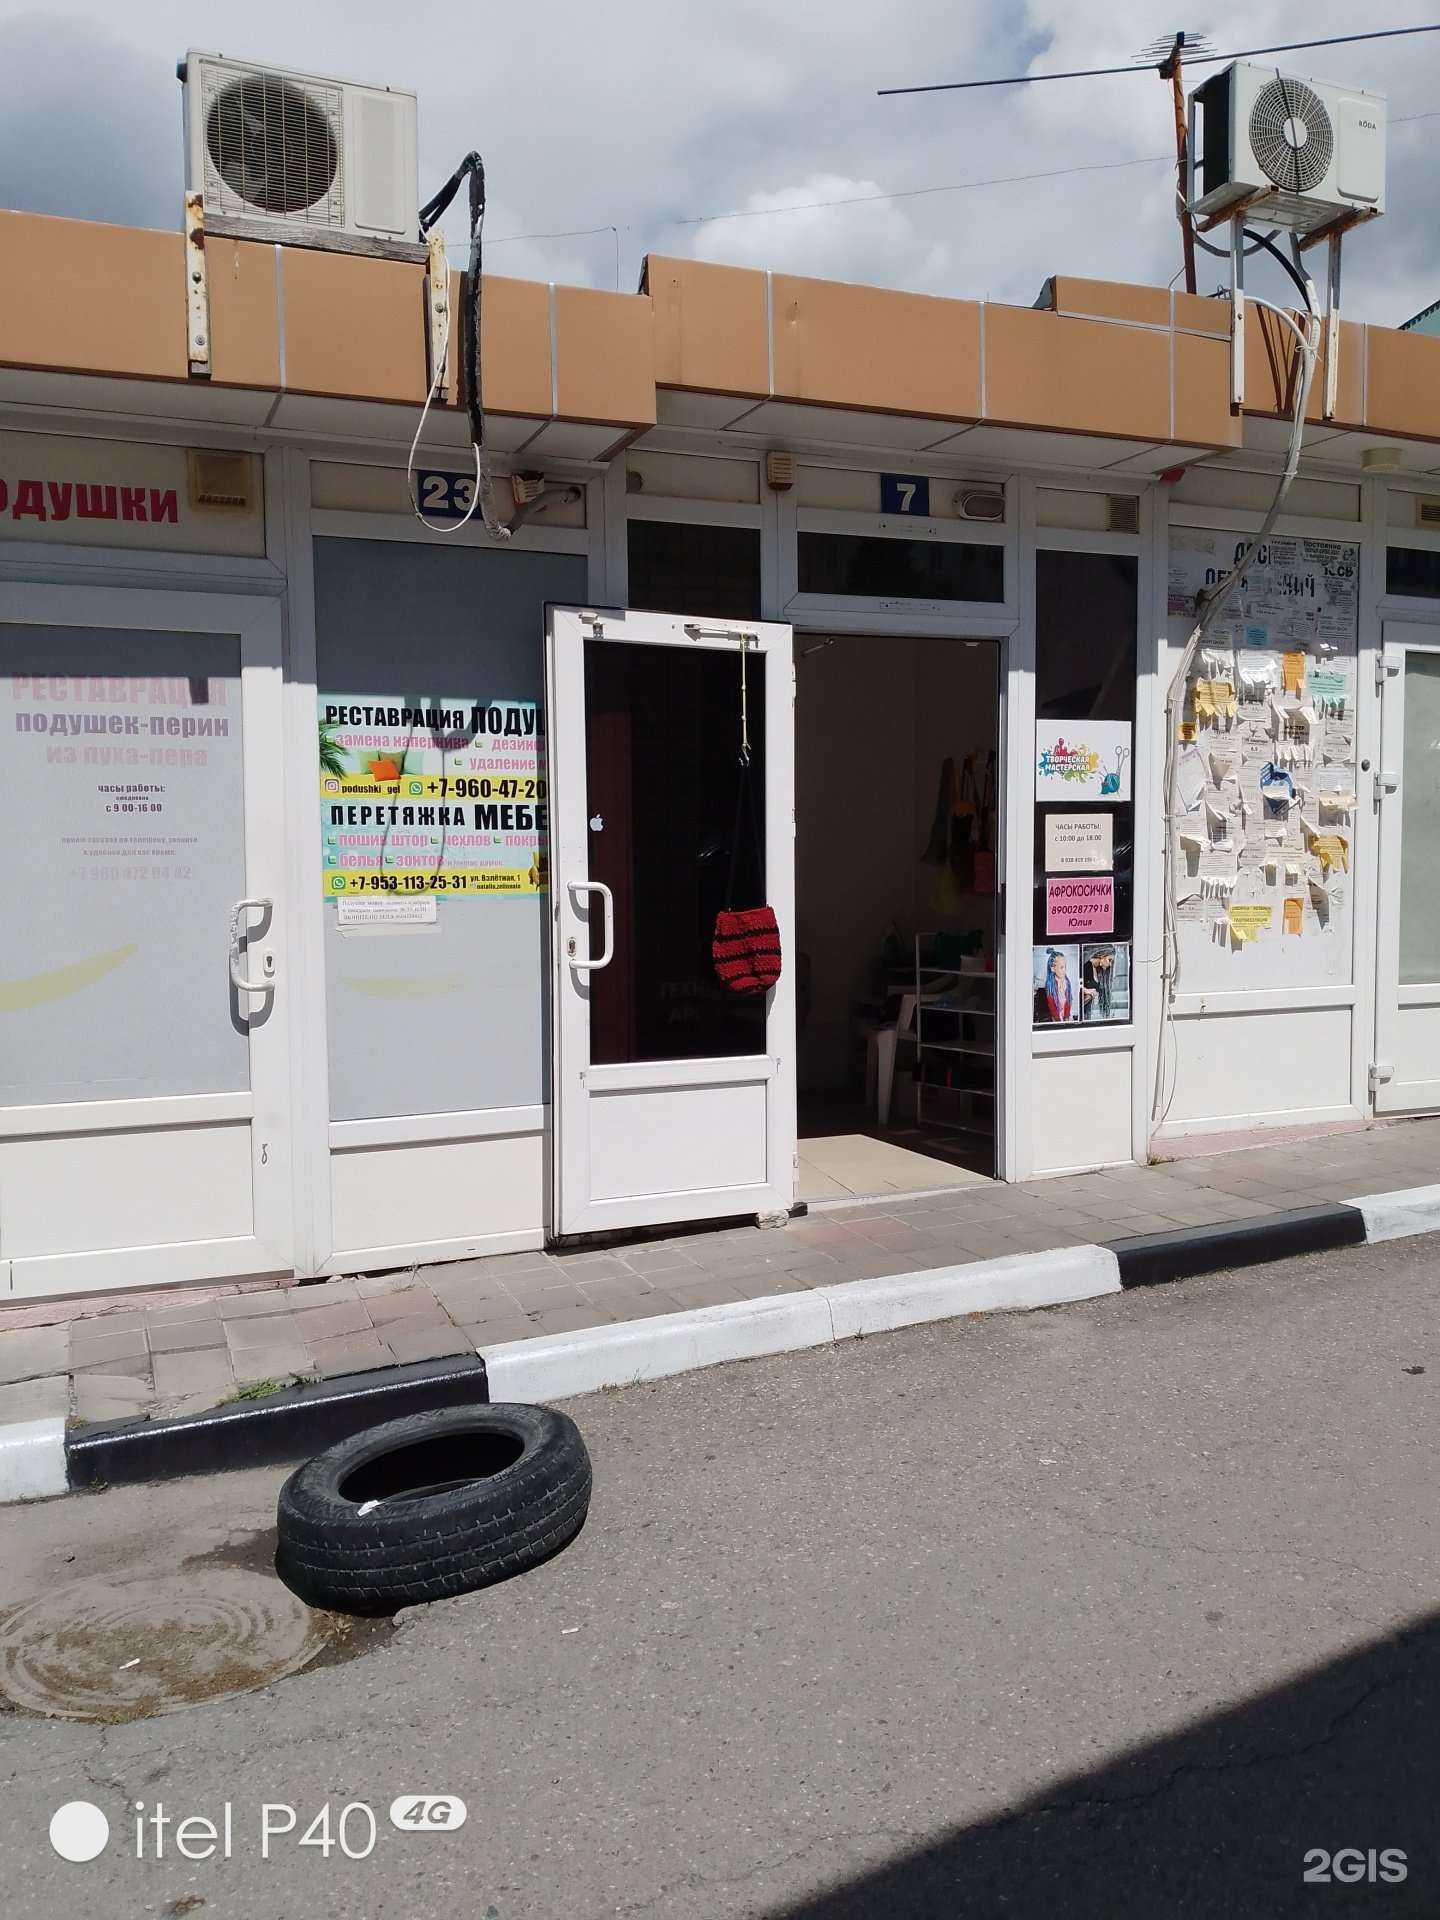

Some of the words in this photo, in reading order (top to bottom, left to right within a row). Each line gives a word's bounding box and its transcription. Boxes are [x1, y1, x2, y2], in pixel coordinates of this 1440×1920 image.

[423, 475, 479, 511] 23
[896, 483, 916, 512] 7
[12, 672, 227, 707] РЕСТАВРАЦЯ
[15, 712, 230, 738] подушек-перин
[325, 705, 464, 731] РЕСТАВРАЦИЯ
[335, 734, 390, 747] замена
[469, 757, 536, 771] удаление
[97, 784, 124, 793] часы
[330, 805, 465, 826] ПЕРЕТЯЖКА
[350, 875, 468, 890] +7-953-113-25-31
[1049, 884, 1112, 898] АФРОКОСИЧКИ
[1051, 904, 1110, 915] 89002877918
[1068, 918, 1092, 927] Юлия
